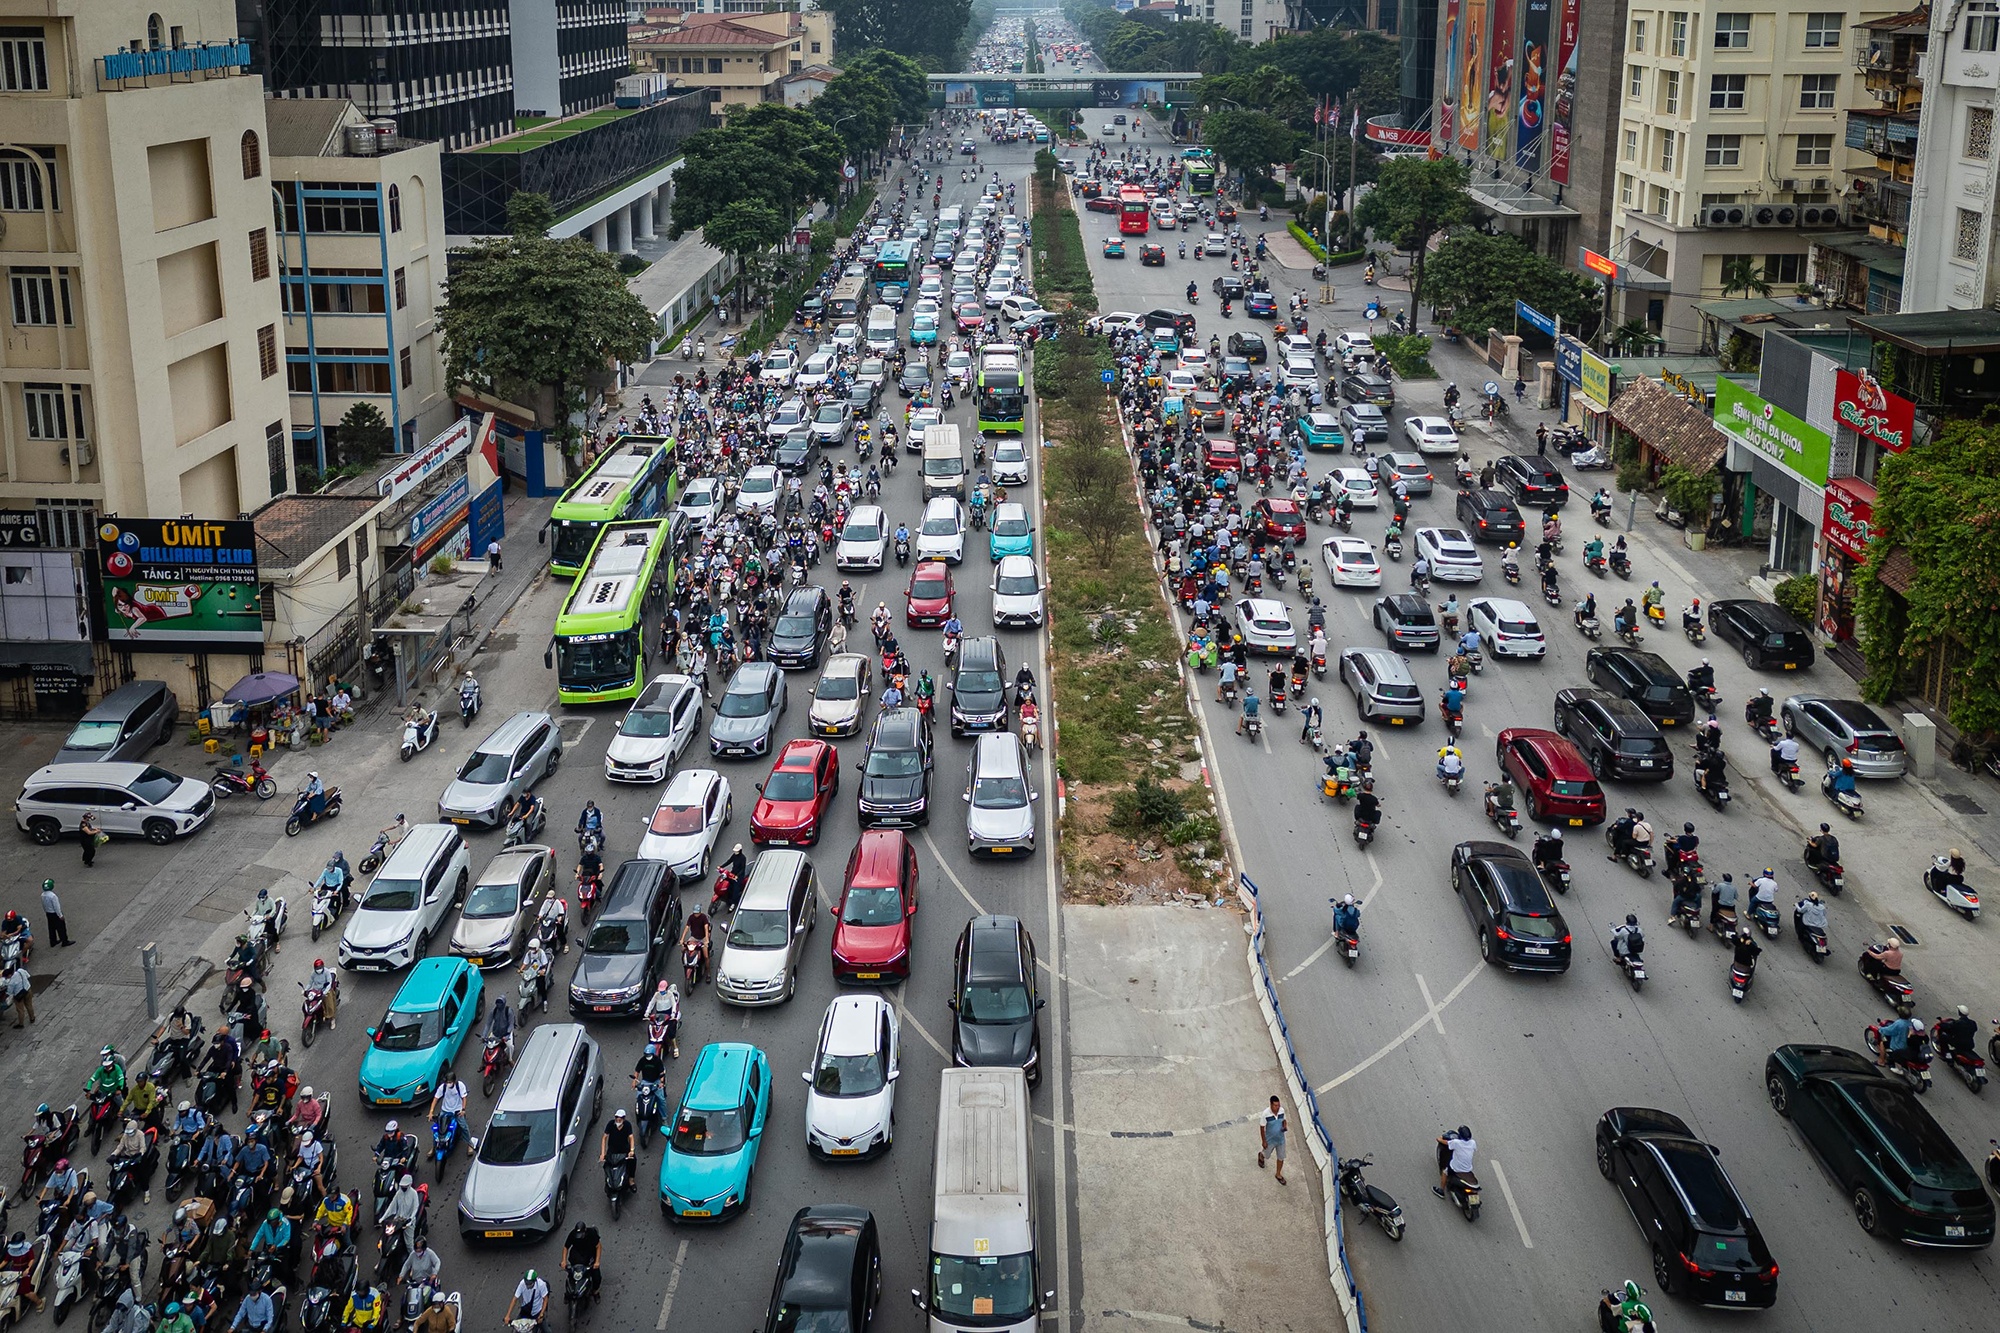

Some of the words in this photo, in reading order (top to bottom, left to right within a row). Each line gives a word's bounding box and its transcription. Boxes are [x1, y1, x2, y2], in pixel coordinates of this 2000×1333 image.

[1386, 131, 1398, 140] MSB
[1733, 402, 1751, 422] BỆNH
[1752, 414, 1767, 433] VIỆN
[1768, 424, 1779, 440] ĐA
[1780, 431, 1803, 454] KHOA
[1838, 400, 1866, 428] Biển
[1863, 415, 1903, 447] Xanh
[1761, 437, 1778, 456] SƠN
[1828, 502, 1855, 530] Biển
[0, 529, 13, 545] y
[217, 549, 253, 564] CLUB
[174, 571, 180, 580] 2
[192, 566, 219, 574] NGUYỄN
